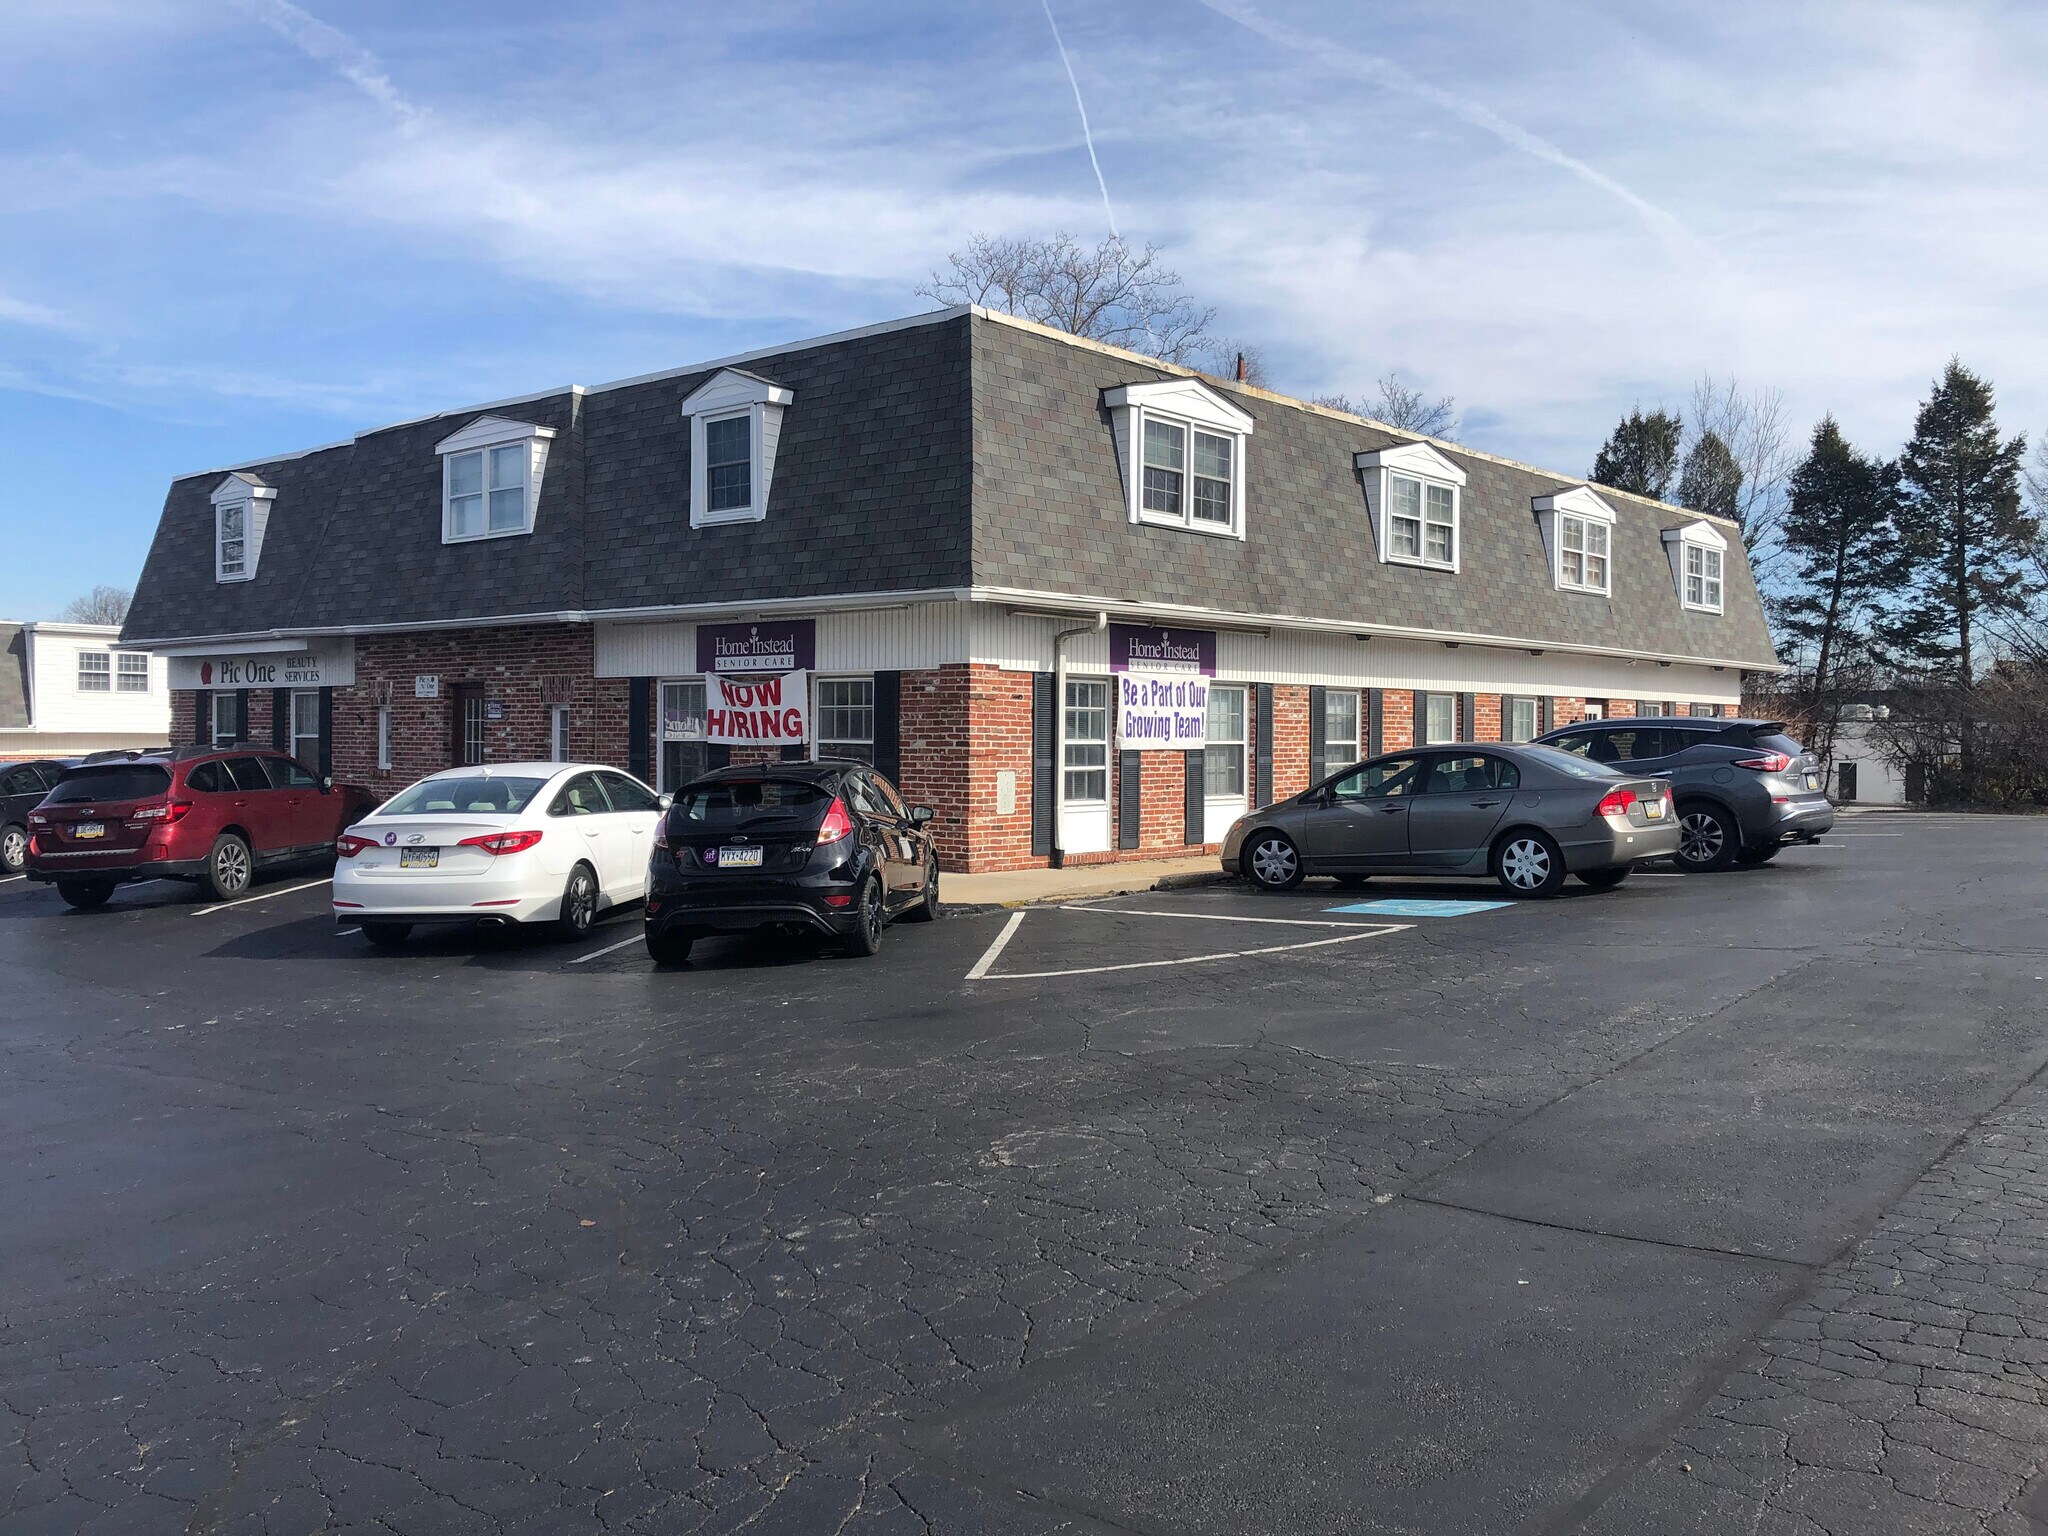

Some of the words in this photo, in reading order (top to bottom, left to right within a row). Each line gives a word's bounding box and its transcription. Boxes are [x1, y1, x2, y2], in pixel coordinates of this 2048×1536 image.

[715, 637, 749, 655] Home
[750, 634, 794, 654] Instead
[1128, 637, 1161, 657] Home
[1161, 641, 1200, 660] Instead
[220, 661, 241, 683] Pic
[245, 660, 276, 683] One
[286, 656, 317, 669] BEAUTY
[717, 658, 757, 668] SENIOR
[764, 657, 792, 666] CARE
[1130, 661, 1168, 671] SENIOR
[1174, 663, 1198, 672] CARE
[284, 670, 320, 682] SERVICES
[720, 678, 782, 708] NOW
[1123, 678, 1138, 706] Be
[1142, 684, 1148, 707] a
[1151, 680, 1173, 707] Part
[1176, 681, 1186, 707] of
[1189, 681, 1206, 707] Our
[707, 708, 803, 738] HIRING
[1125, 711, 1171, 742] Growing
[1174, 712, 1205, 738] Team!
